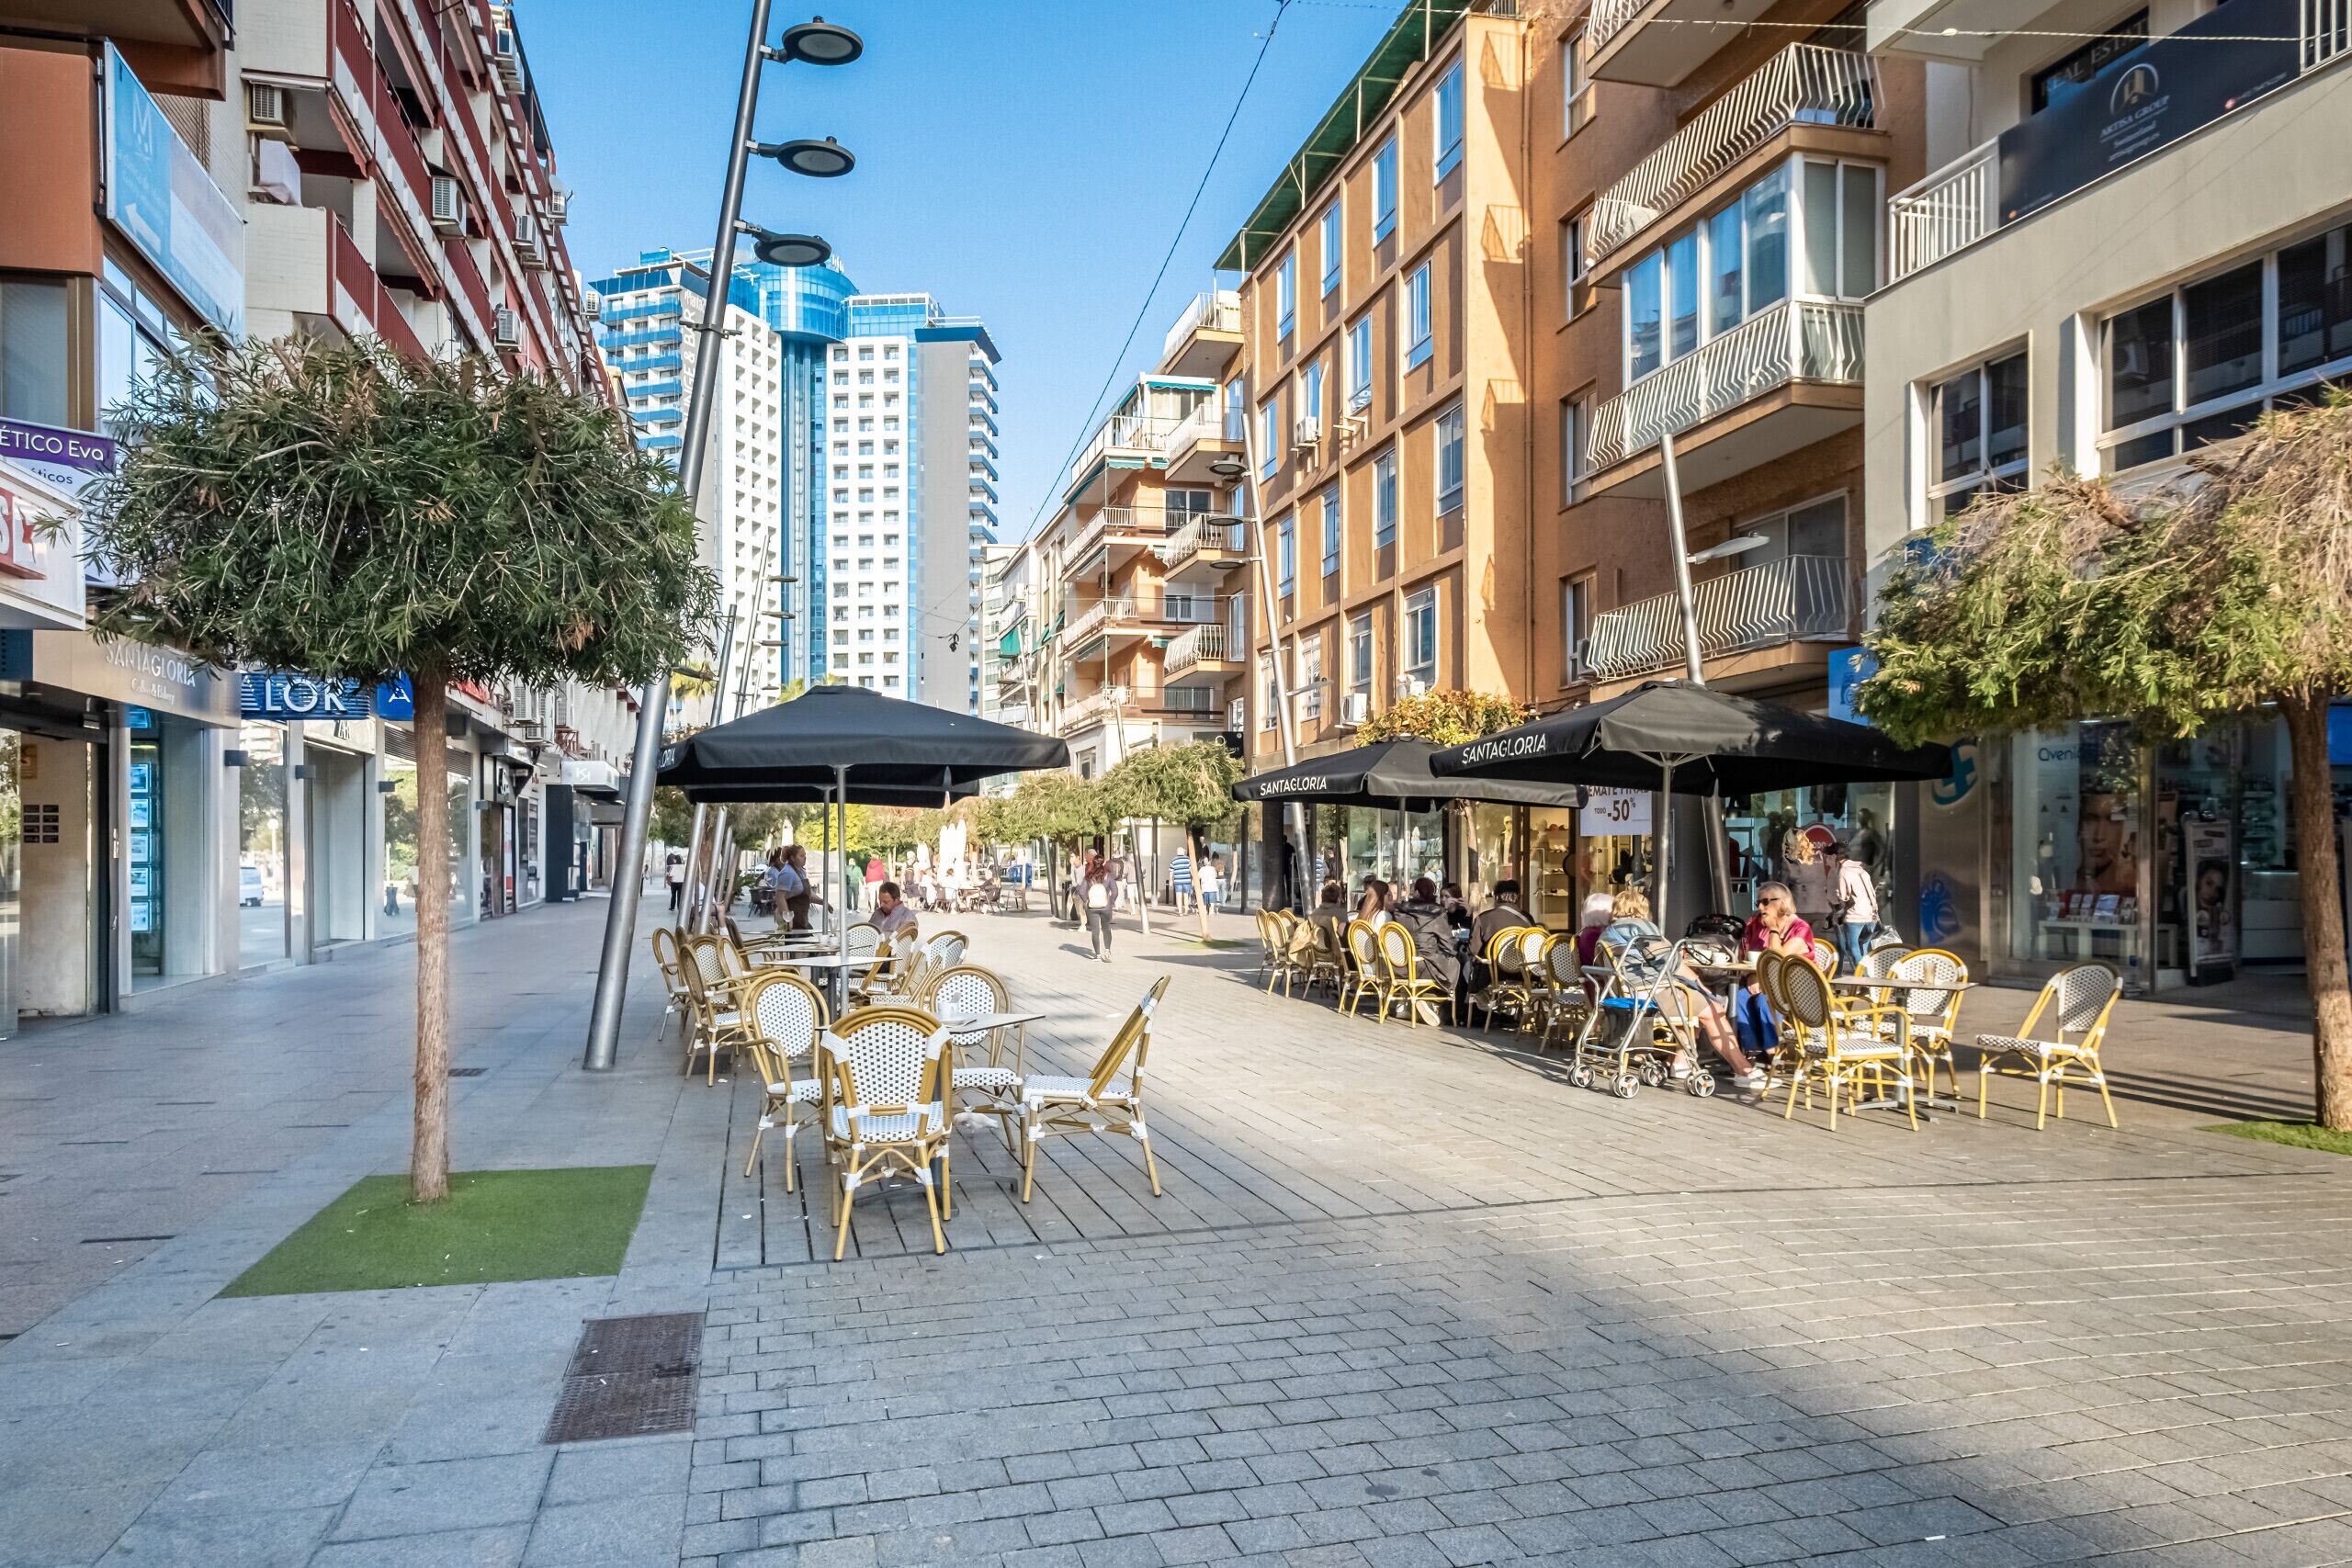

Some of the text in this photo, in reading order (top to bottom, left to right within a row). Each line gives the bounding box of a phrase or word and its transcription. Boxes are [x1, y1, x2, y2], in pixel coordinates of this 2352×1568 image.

[68, 440, 104, 461] Eva
[106, 642, 196, 687] SANTAGLORIA
[1462, 733, 1546, 764] SANTAGLORIA
[1260, 776, 1328, 796] SANTAGLORIA
